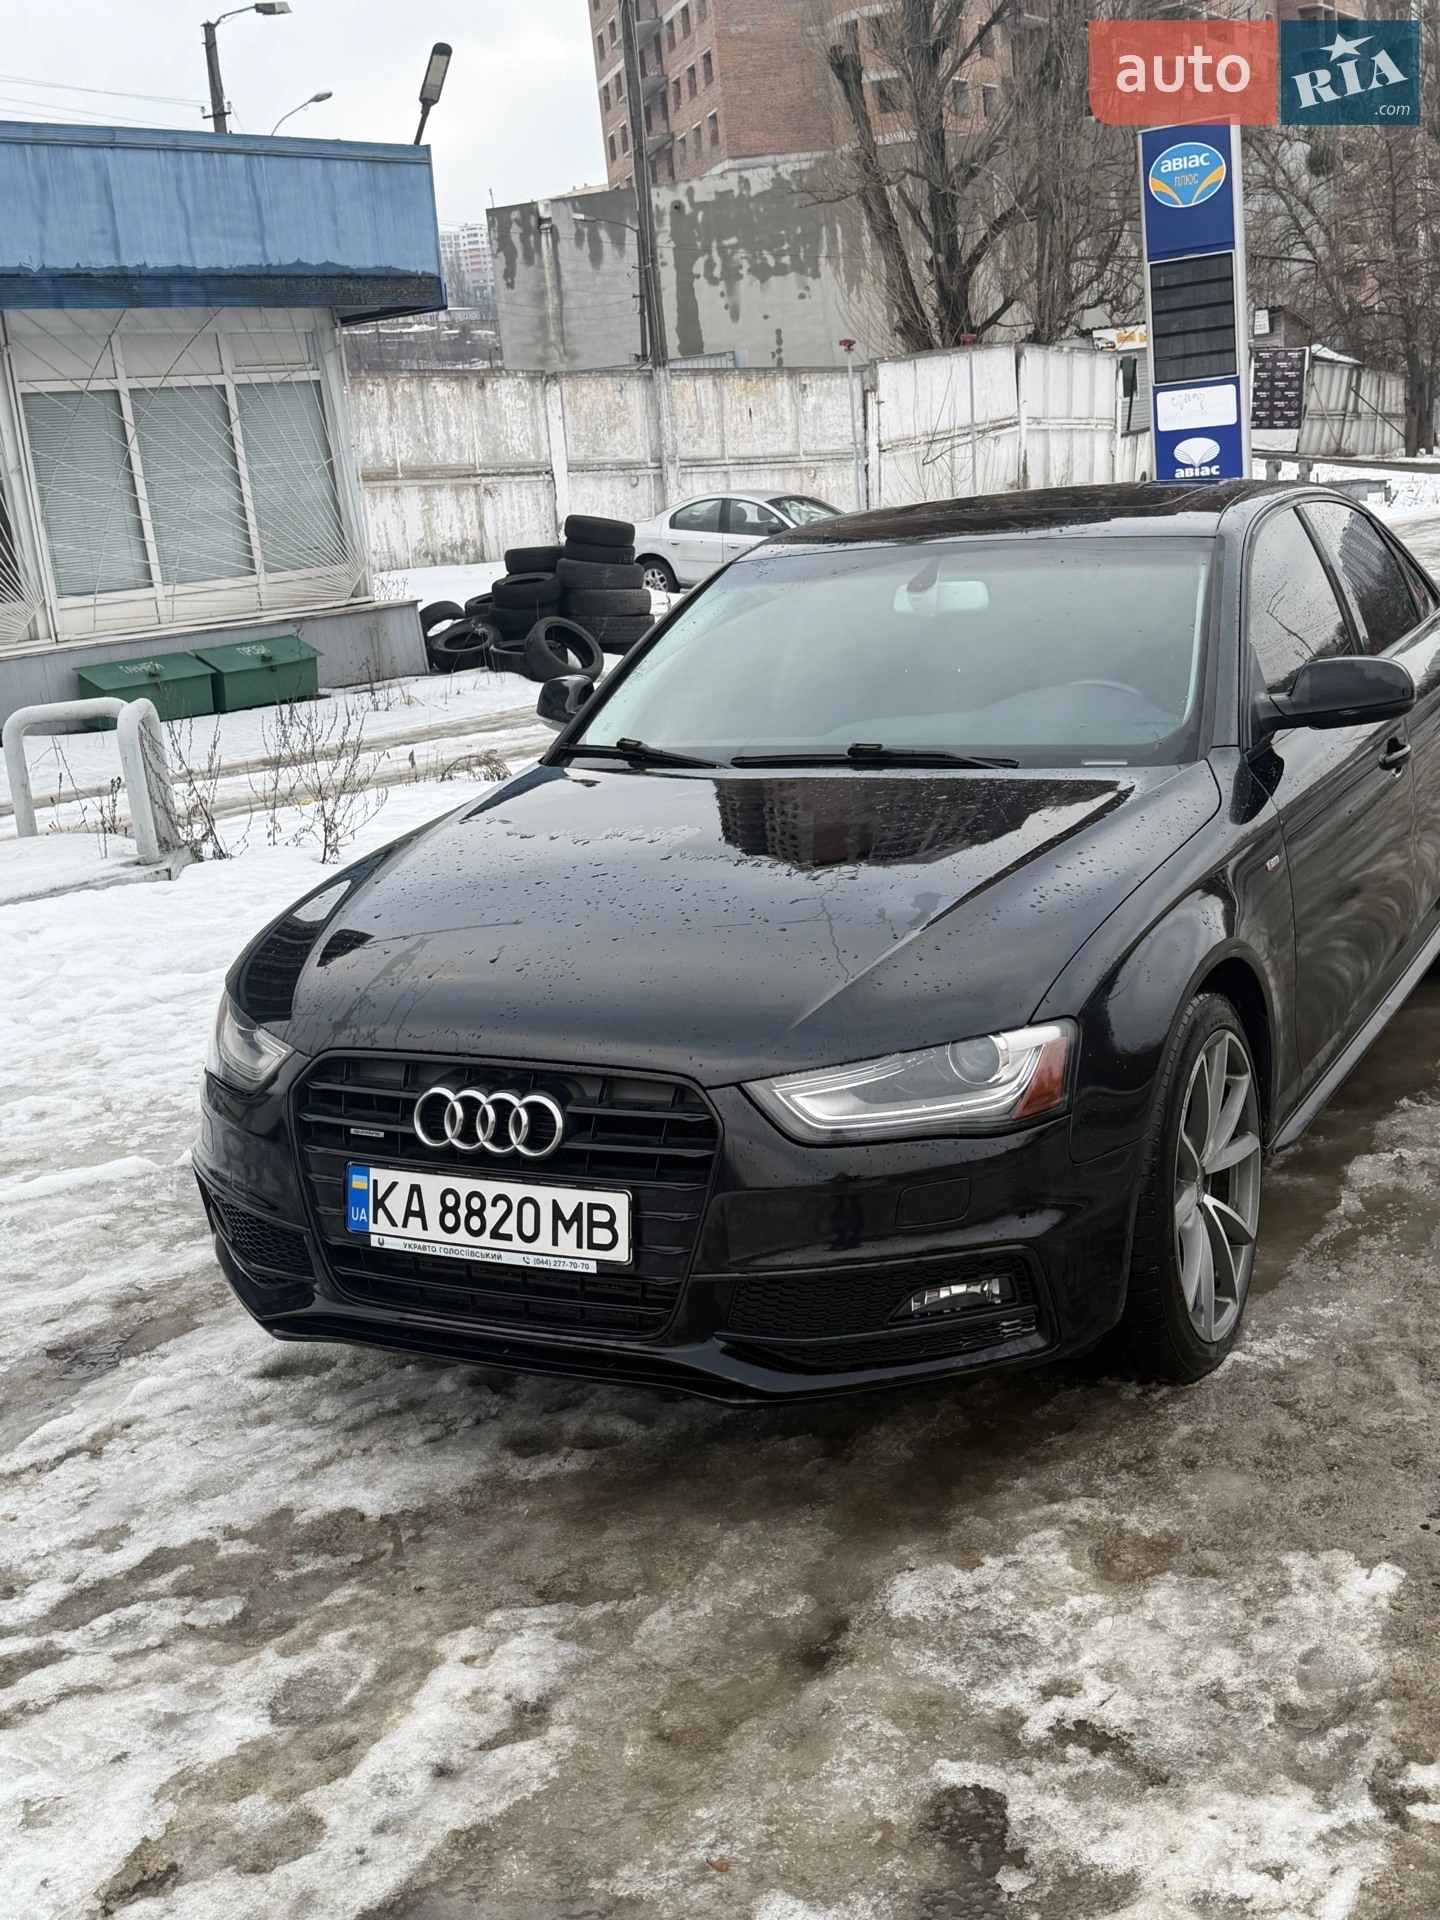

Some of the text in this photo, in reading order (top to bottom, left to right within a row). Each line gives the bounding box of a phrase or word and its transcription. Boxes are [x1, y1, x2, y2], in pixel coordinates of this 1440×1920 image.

[351, 1206, 368, 1222] UA
[372, 1178, 619, 1252] KA 8820 MB
[403, 1242, 503, 1261] УКРАВТО ГОЛОСІЇВСЬКИЙ
[533, 1257, 590, 1270] (044) 277-70-70
